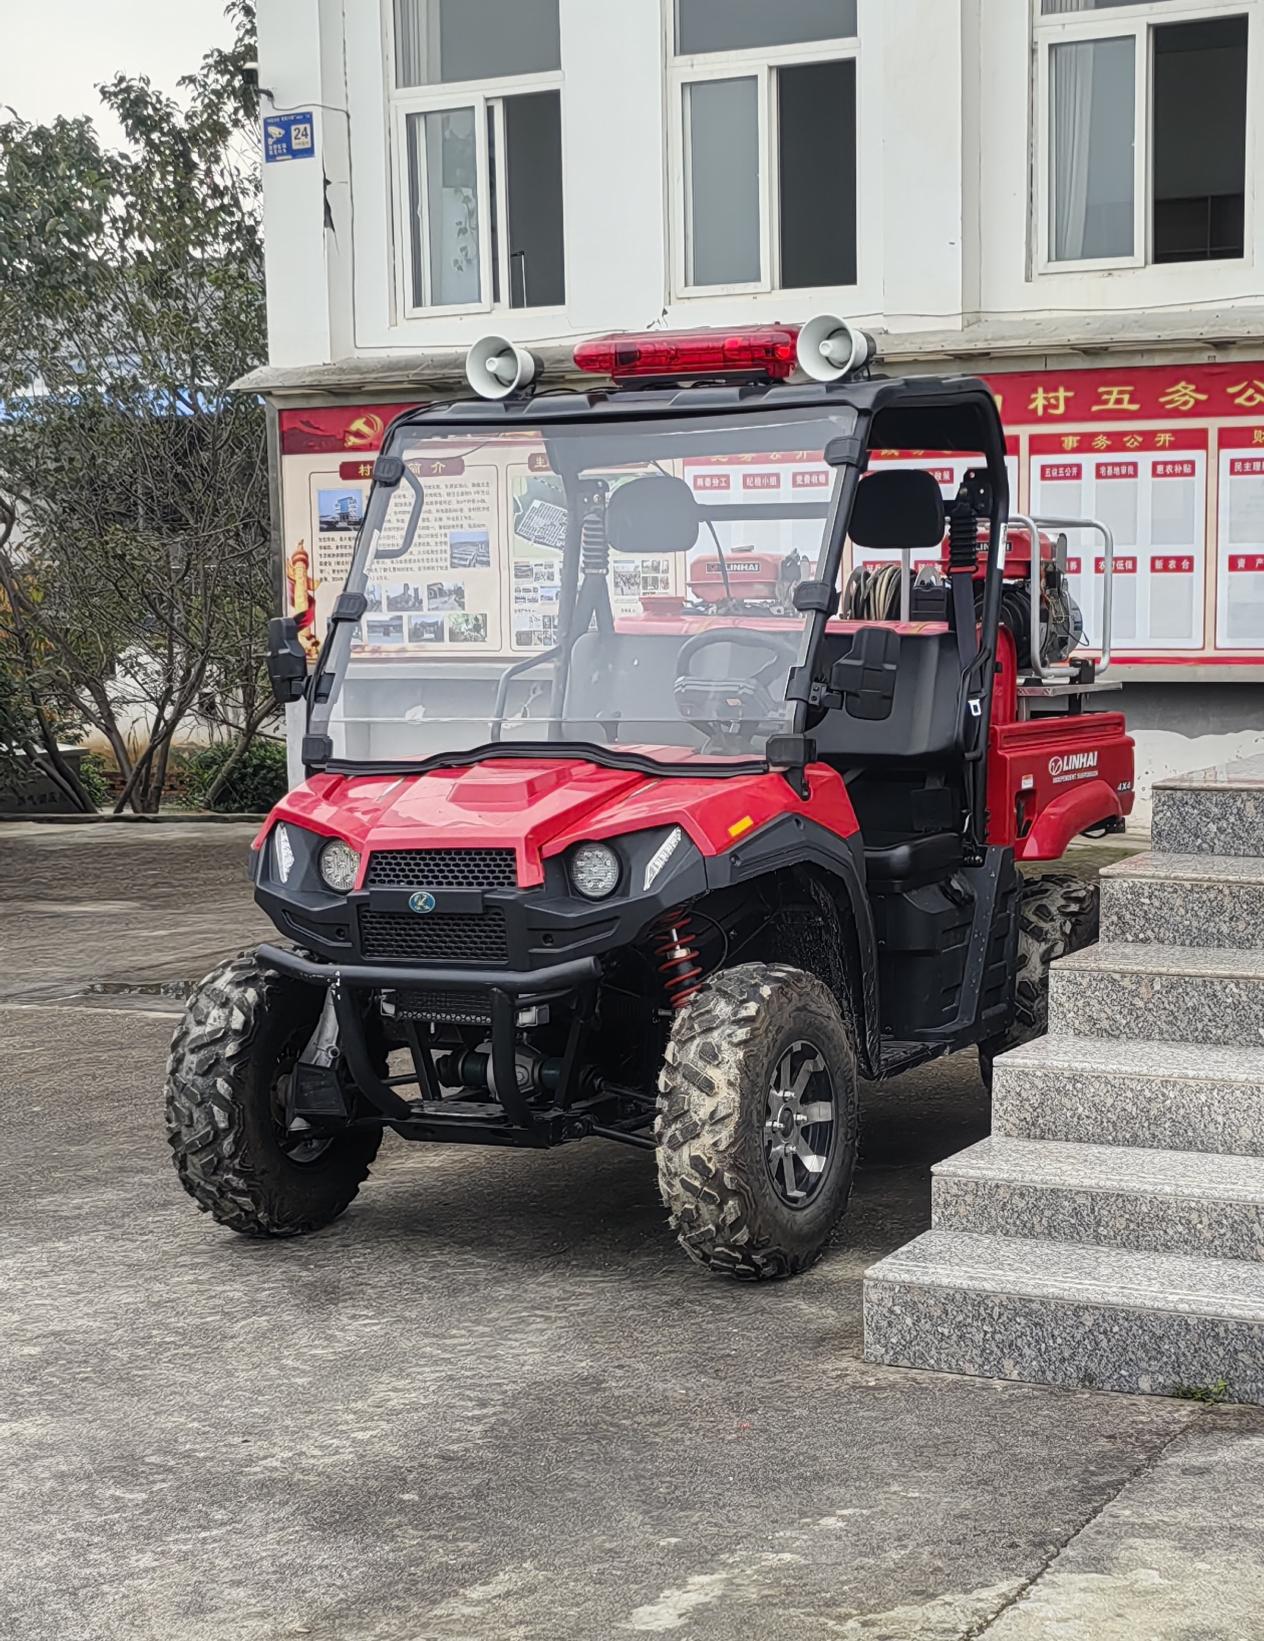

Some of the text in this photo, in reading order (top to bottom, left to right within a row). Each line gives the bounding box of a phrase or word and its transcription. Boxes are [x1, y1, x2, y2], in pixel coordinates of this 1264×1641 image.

[294, 126, 308, 140] 24
[996, 380, 1264, 416] 村五务公
[1061, 432, 1175, 450] 事务公开
[358, 462, 446, 477] 村简介
[1234, 461, 1264, 472] 民主理
[725, 562, 759, 572] LINHAI
[1098, 559, 1133, 571] 农低保
[1062, 751, 1098, 772] LINHAI
